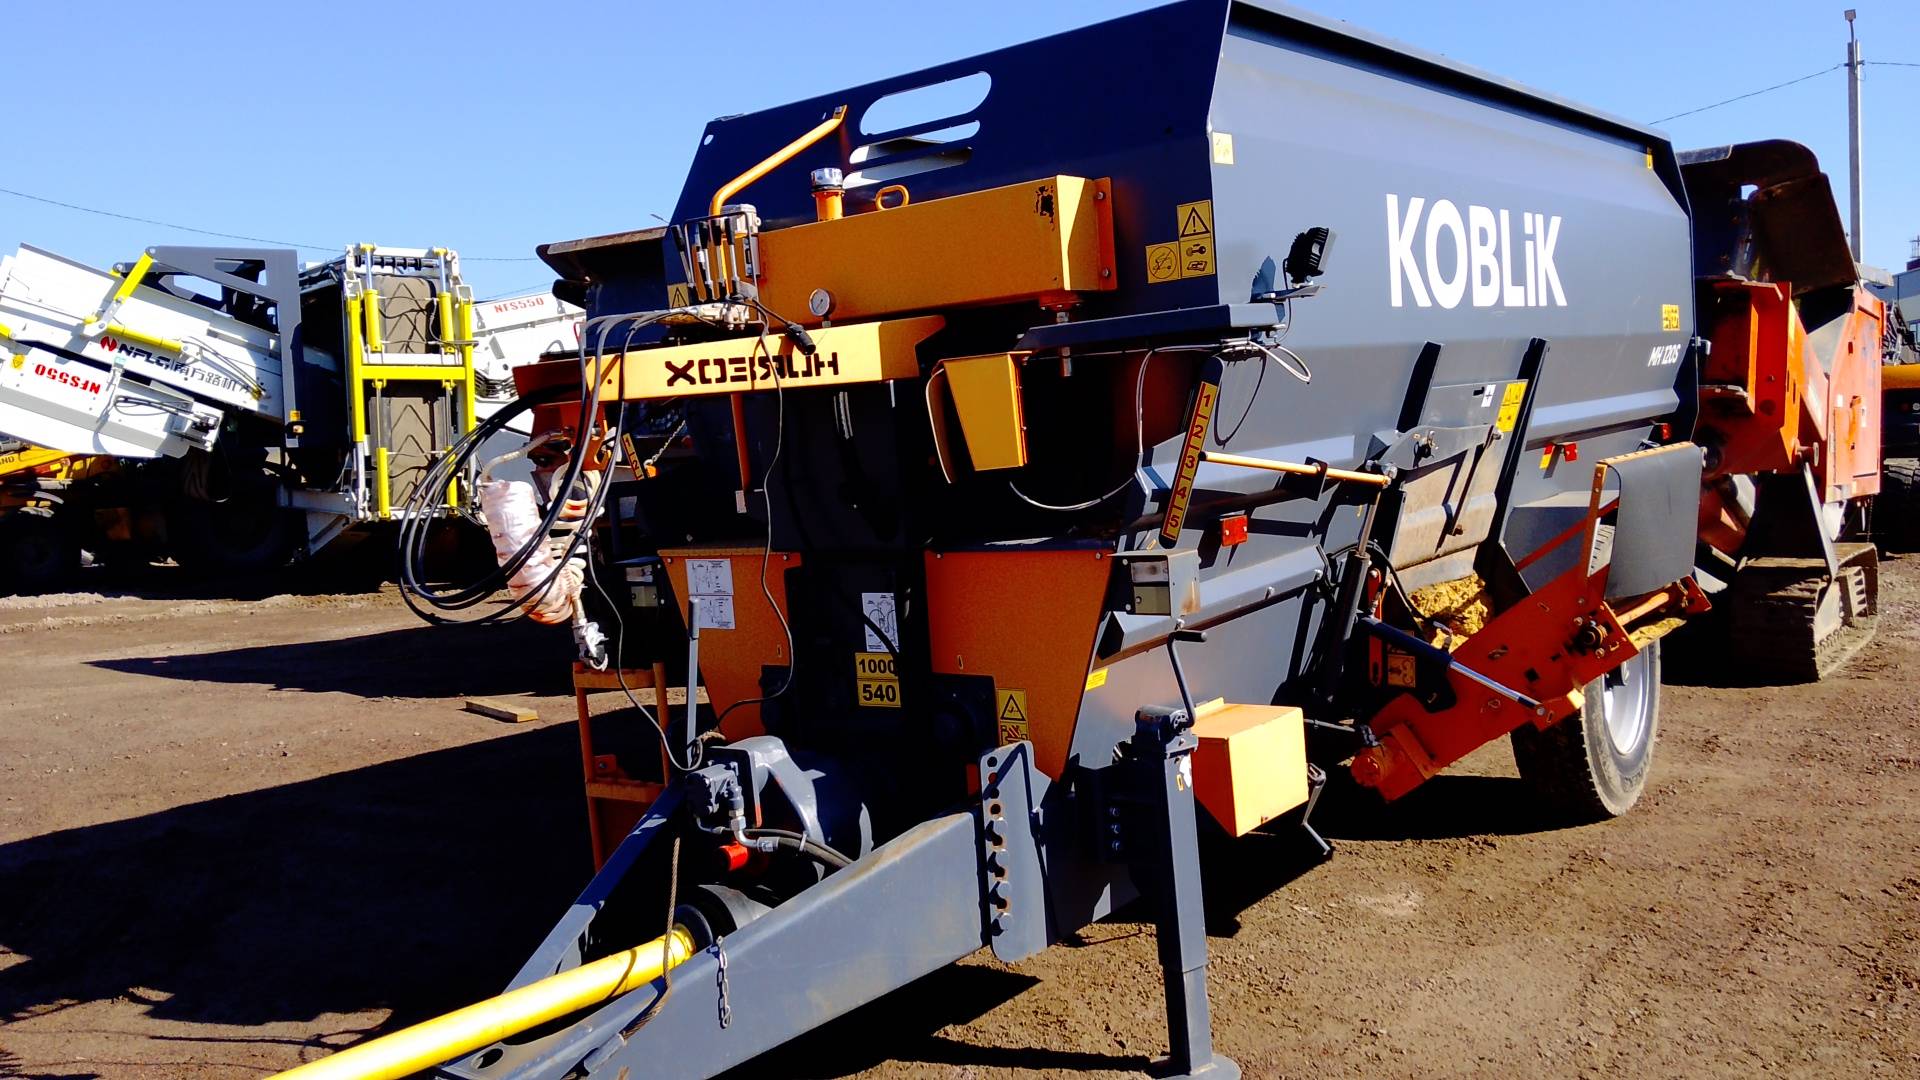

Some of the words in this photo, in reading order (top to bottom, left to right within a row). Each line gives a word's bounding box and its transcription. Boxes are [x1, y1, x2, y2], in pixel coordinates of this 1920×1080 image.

[494, 297, 545, 313] NFS550
[117, 343, 170, 369] NFLG
[35, 364, 101, 395] NFS550
[858, 658, 897, 675] 1000
[862, 684, 896, 702] 540
